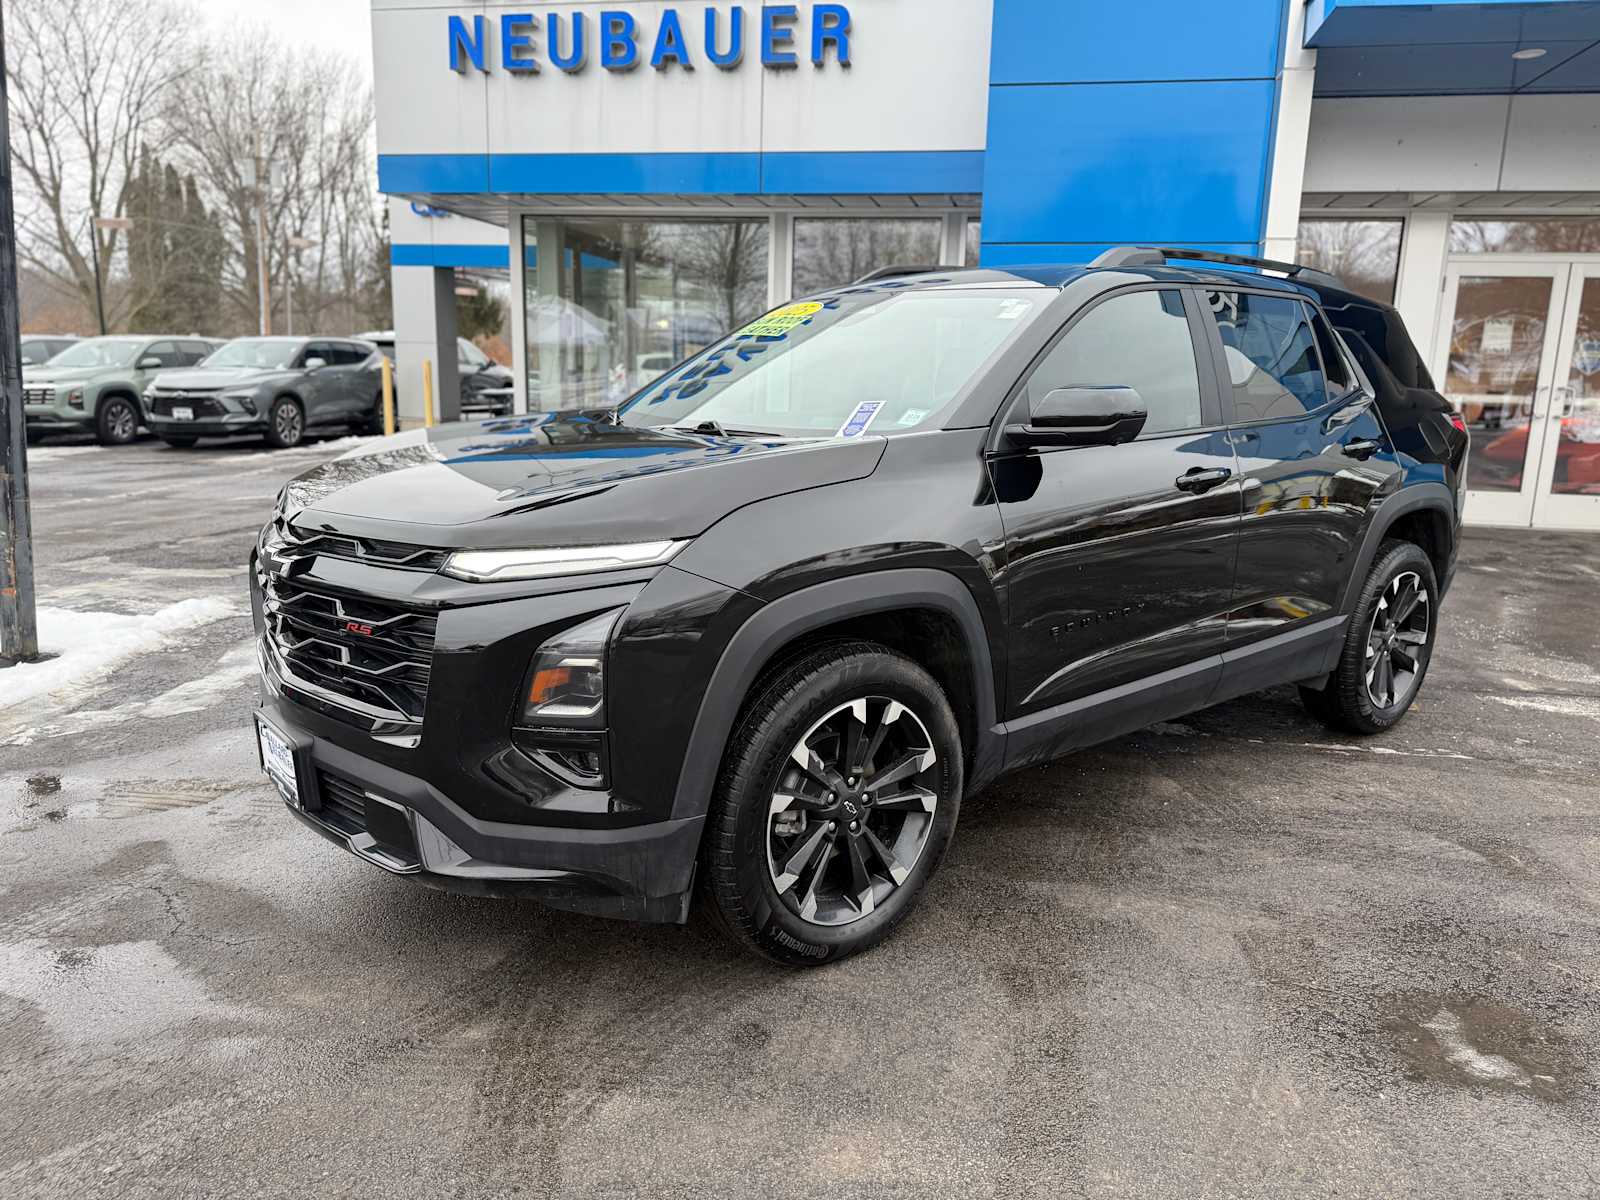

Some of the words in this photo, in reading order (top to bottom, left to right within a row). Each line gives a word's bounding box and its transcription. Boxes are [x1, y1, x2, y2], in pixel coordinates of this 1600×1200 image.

[448, 4, 853, 74] NEUBAUER
[346, 622, 373, 637] RS
[773, 928, 830, 959] Continental
